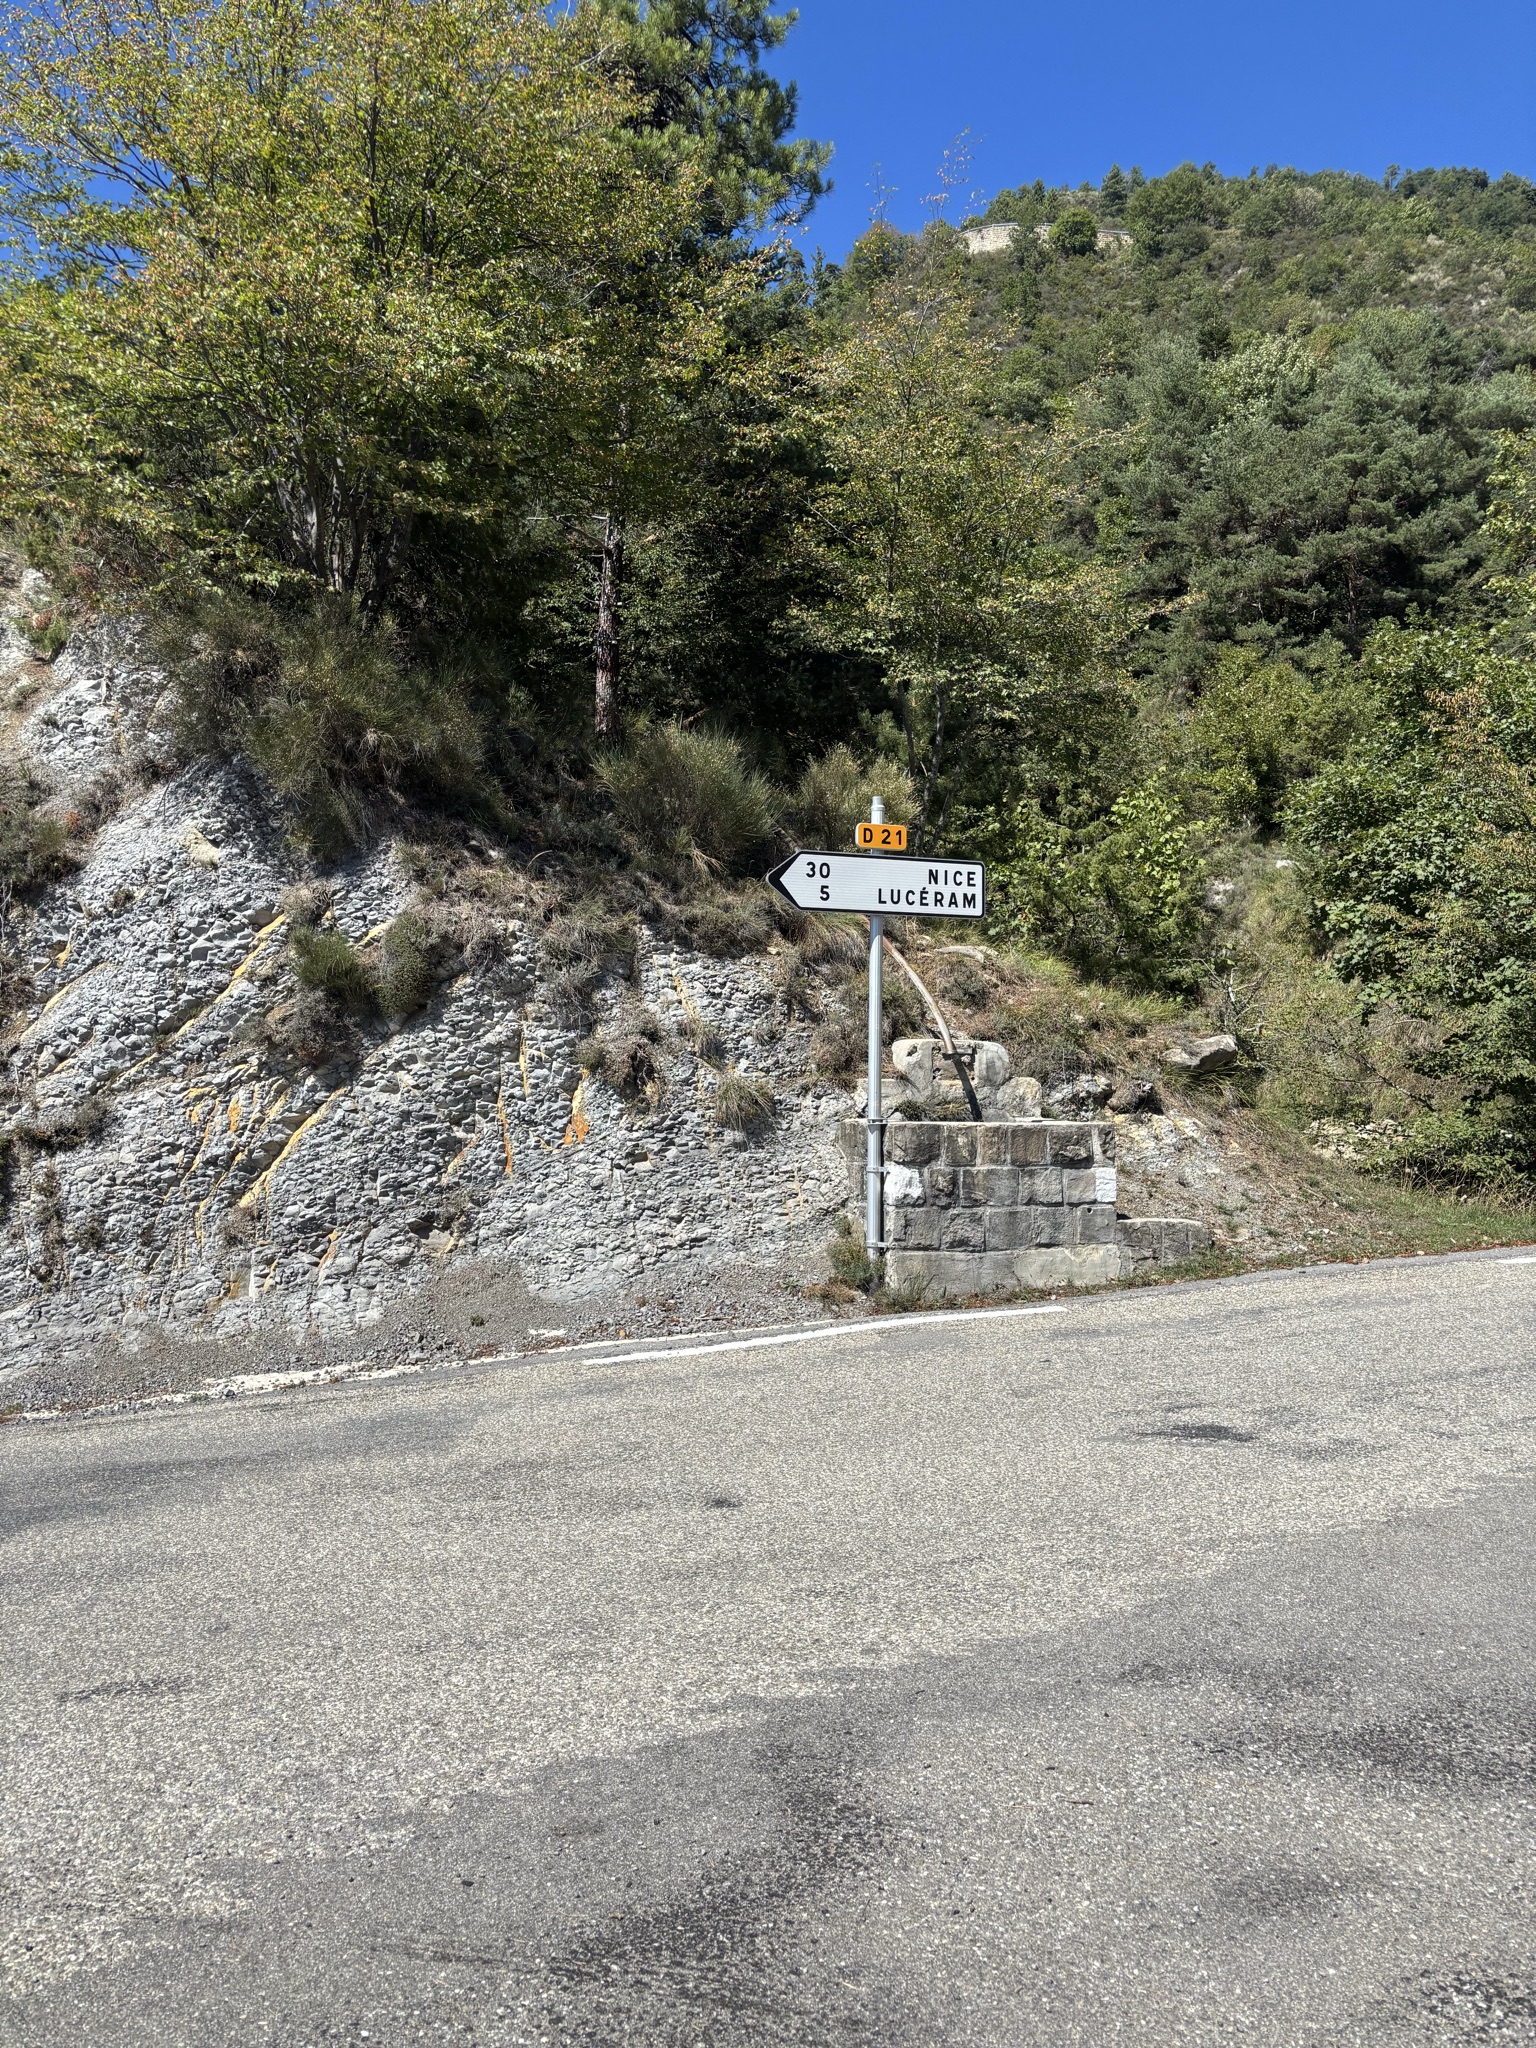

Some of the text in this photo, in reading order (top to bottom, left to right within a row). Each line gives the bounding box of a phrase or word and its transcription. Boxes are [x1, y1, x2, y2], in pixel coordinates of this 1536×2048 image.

[863, 828, 903, 846] D 21
[805, 861, 976, 887] 30 NICE
[819, 885, 976, 909] 5 LUCÉRAM
